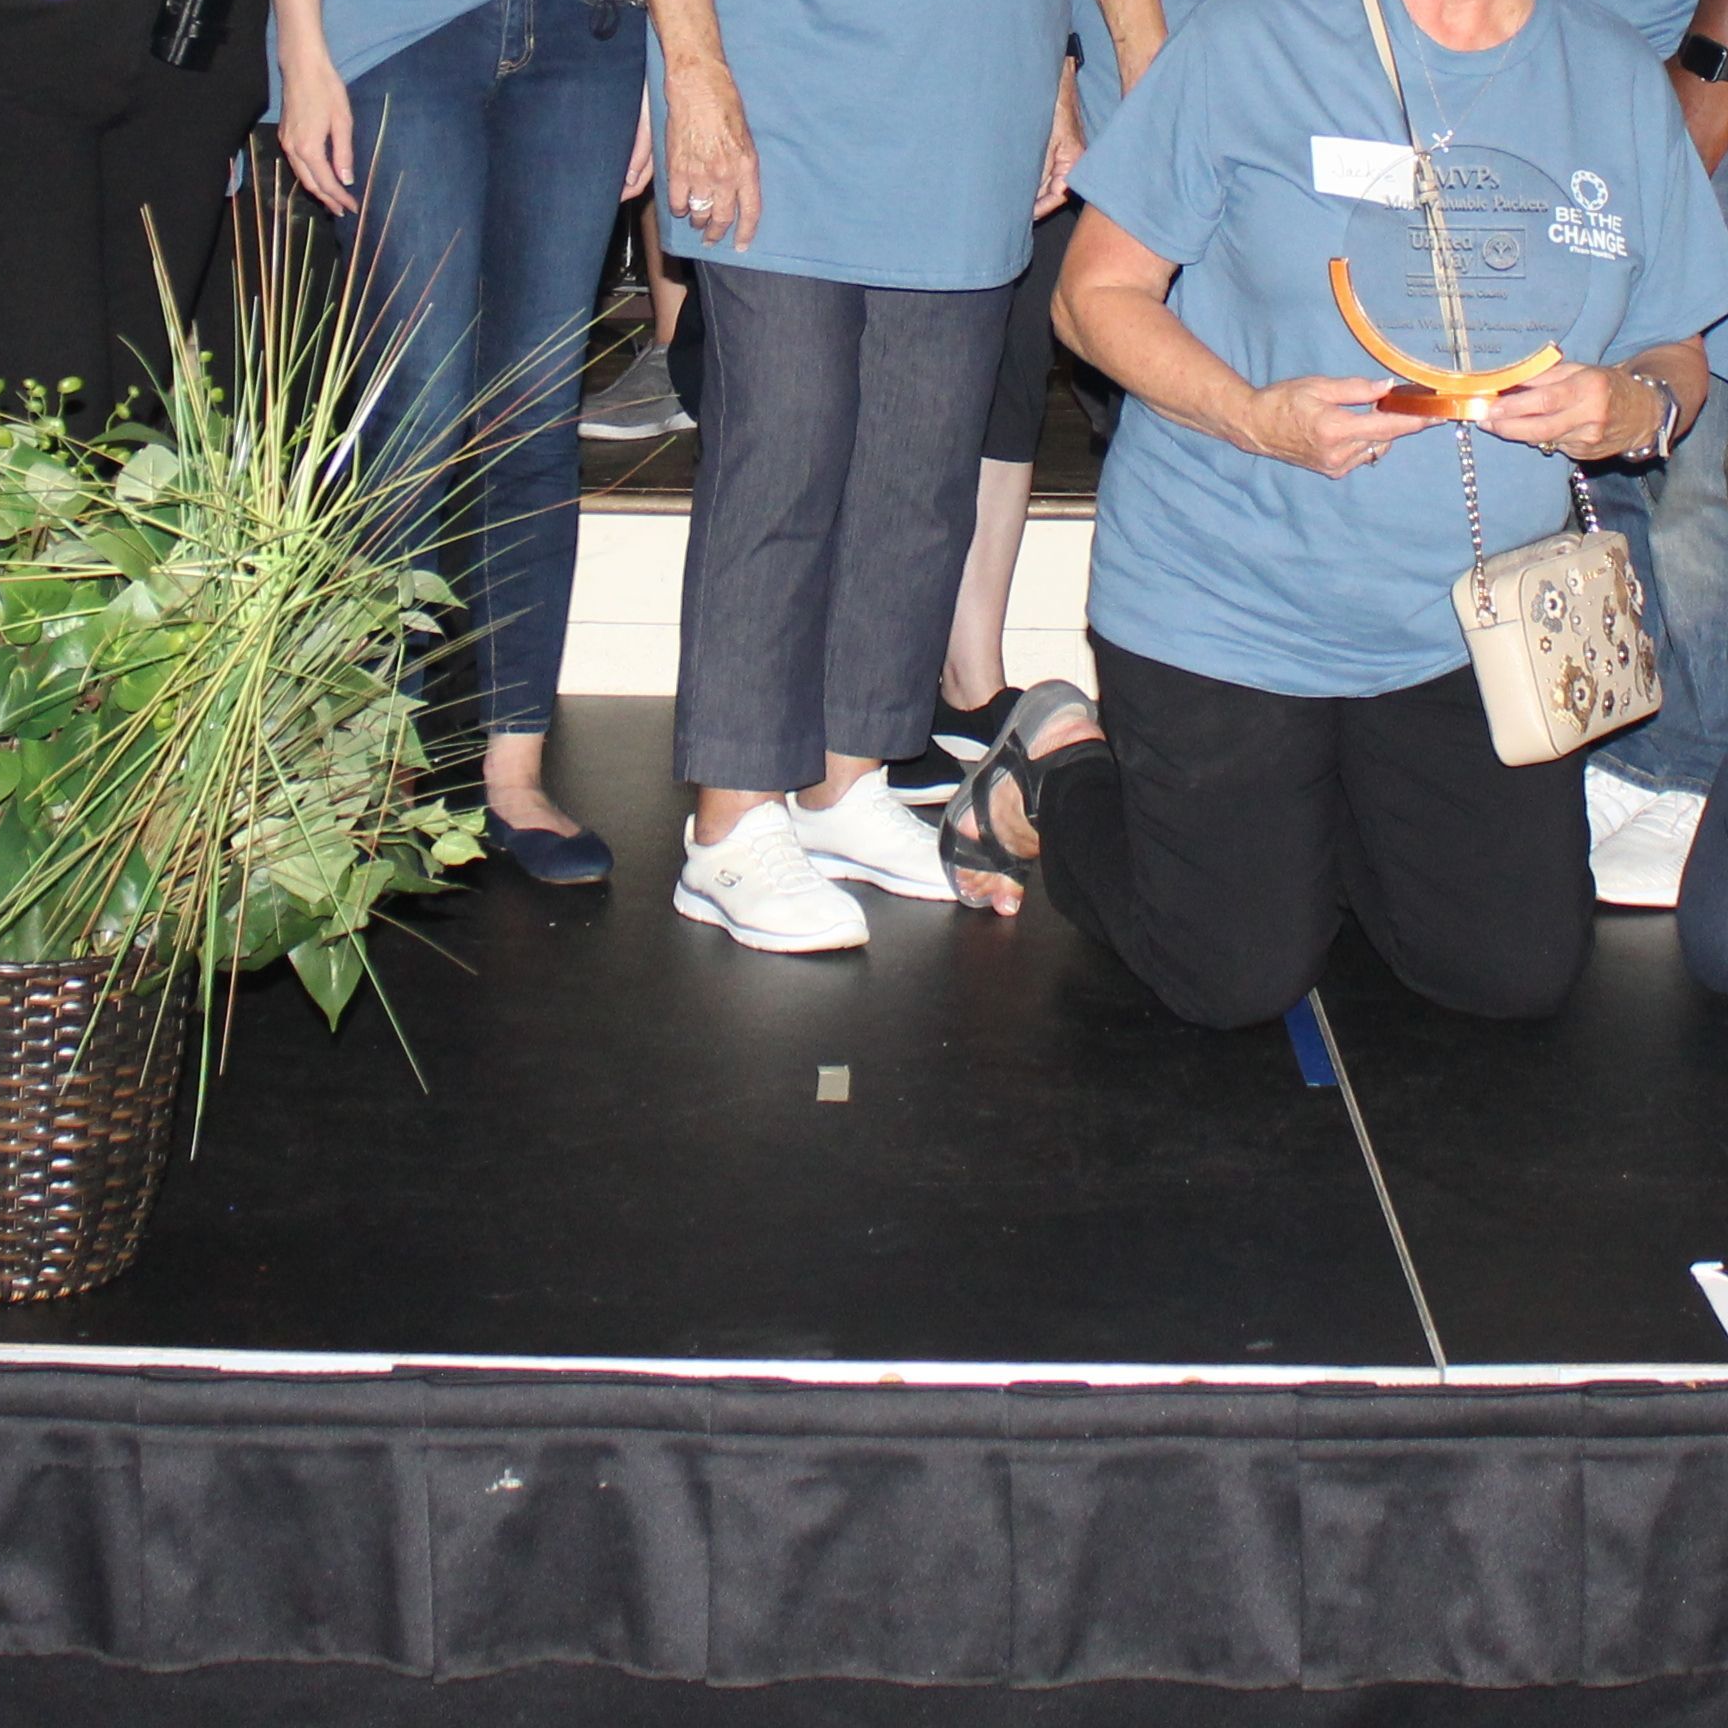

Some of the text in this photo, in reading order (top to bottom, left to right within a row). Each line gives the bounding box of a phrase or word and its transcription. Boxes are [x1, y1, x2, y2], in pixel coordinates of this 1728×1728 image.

[1555, 206, 1622, 234] BE THE
[1548, 223, 1628, 257] CHANGE
